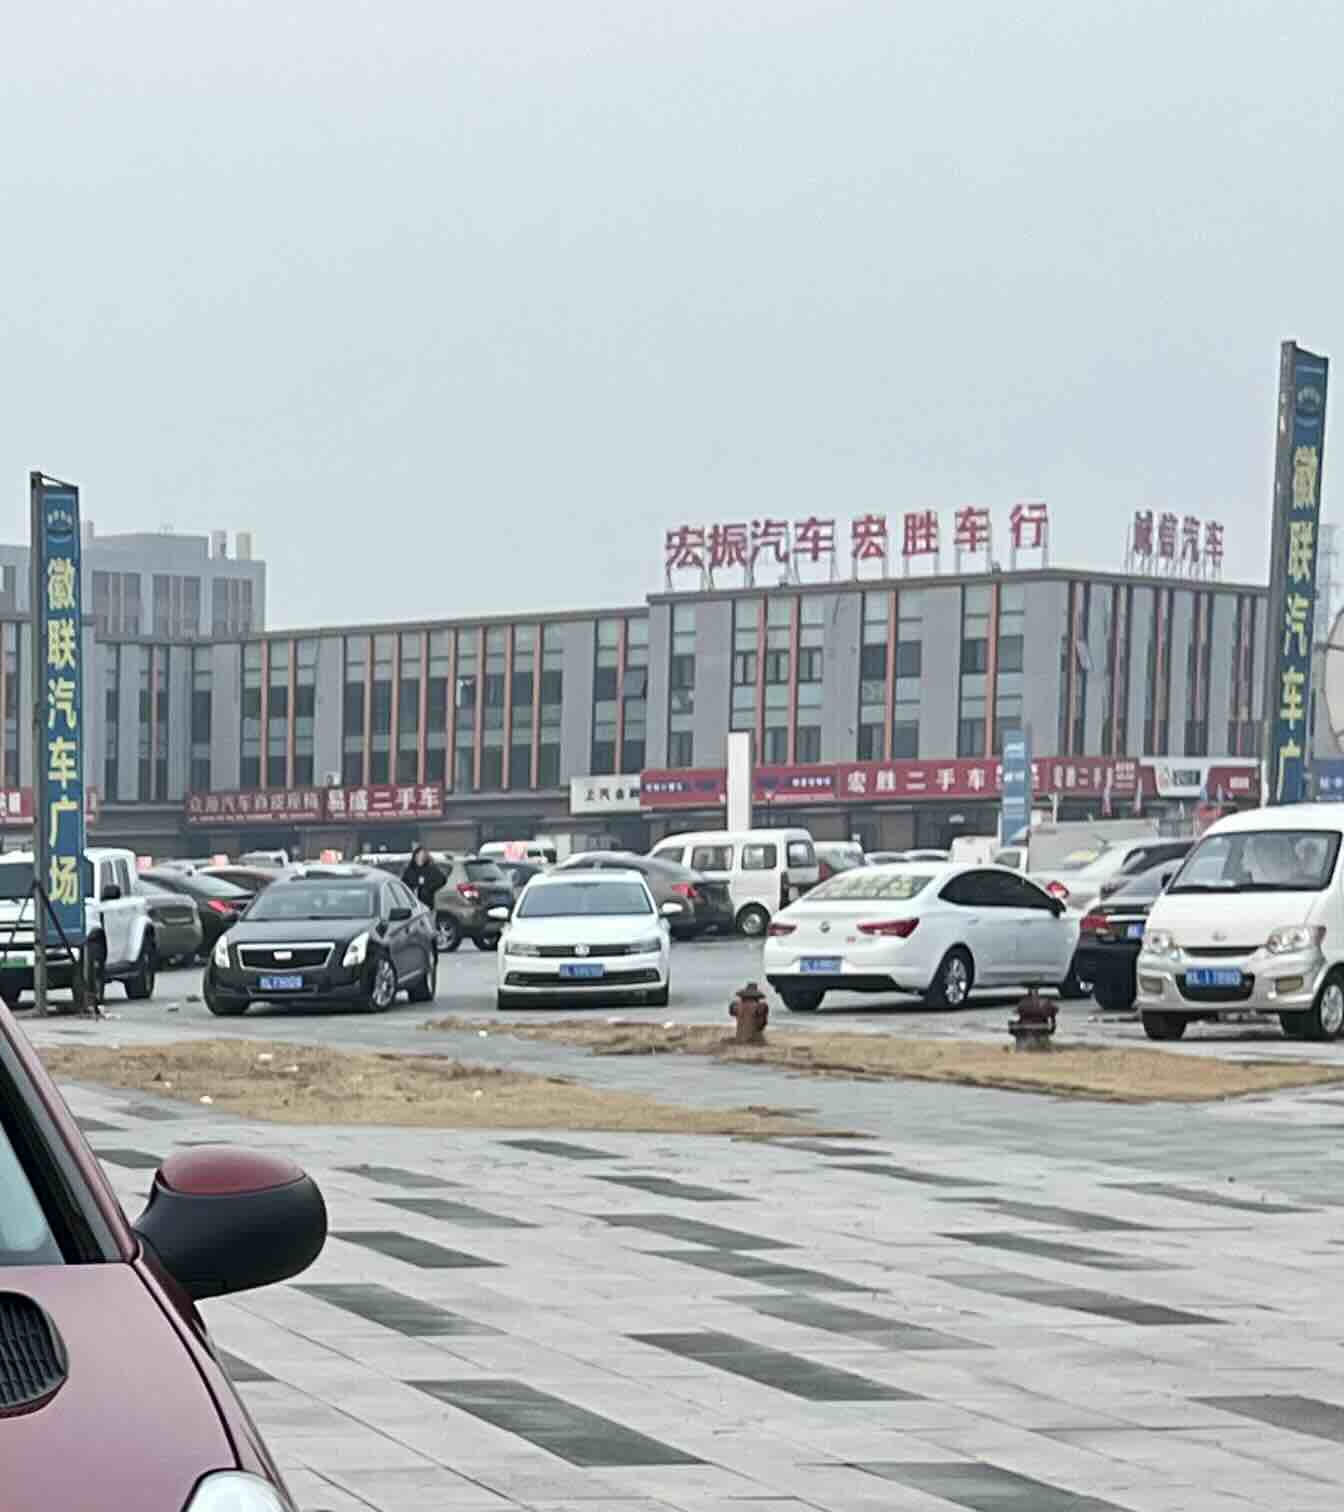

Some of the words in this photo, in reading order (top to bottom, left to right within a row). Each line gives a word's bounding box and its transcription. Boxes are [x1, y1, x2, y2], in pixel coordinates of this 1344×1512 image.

[665, 514, 836, 570] 宏振汽车
[851, 502, 1048, 562] 宏胜车行
[46, 557, 79, 905] 徽联汽车广场
